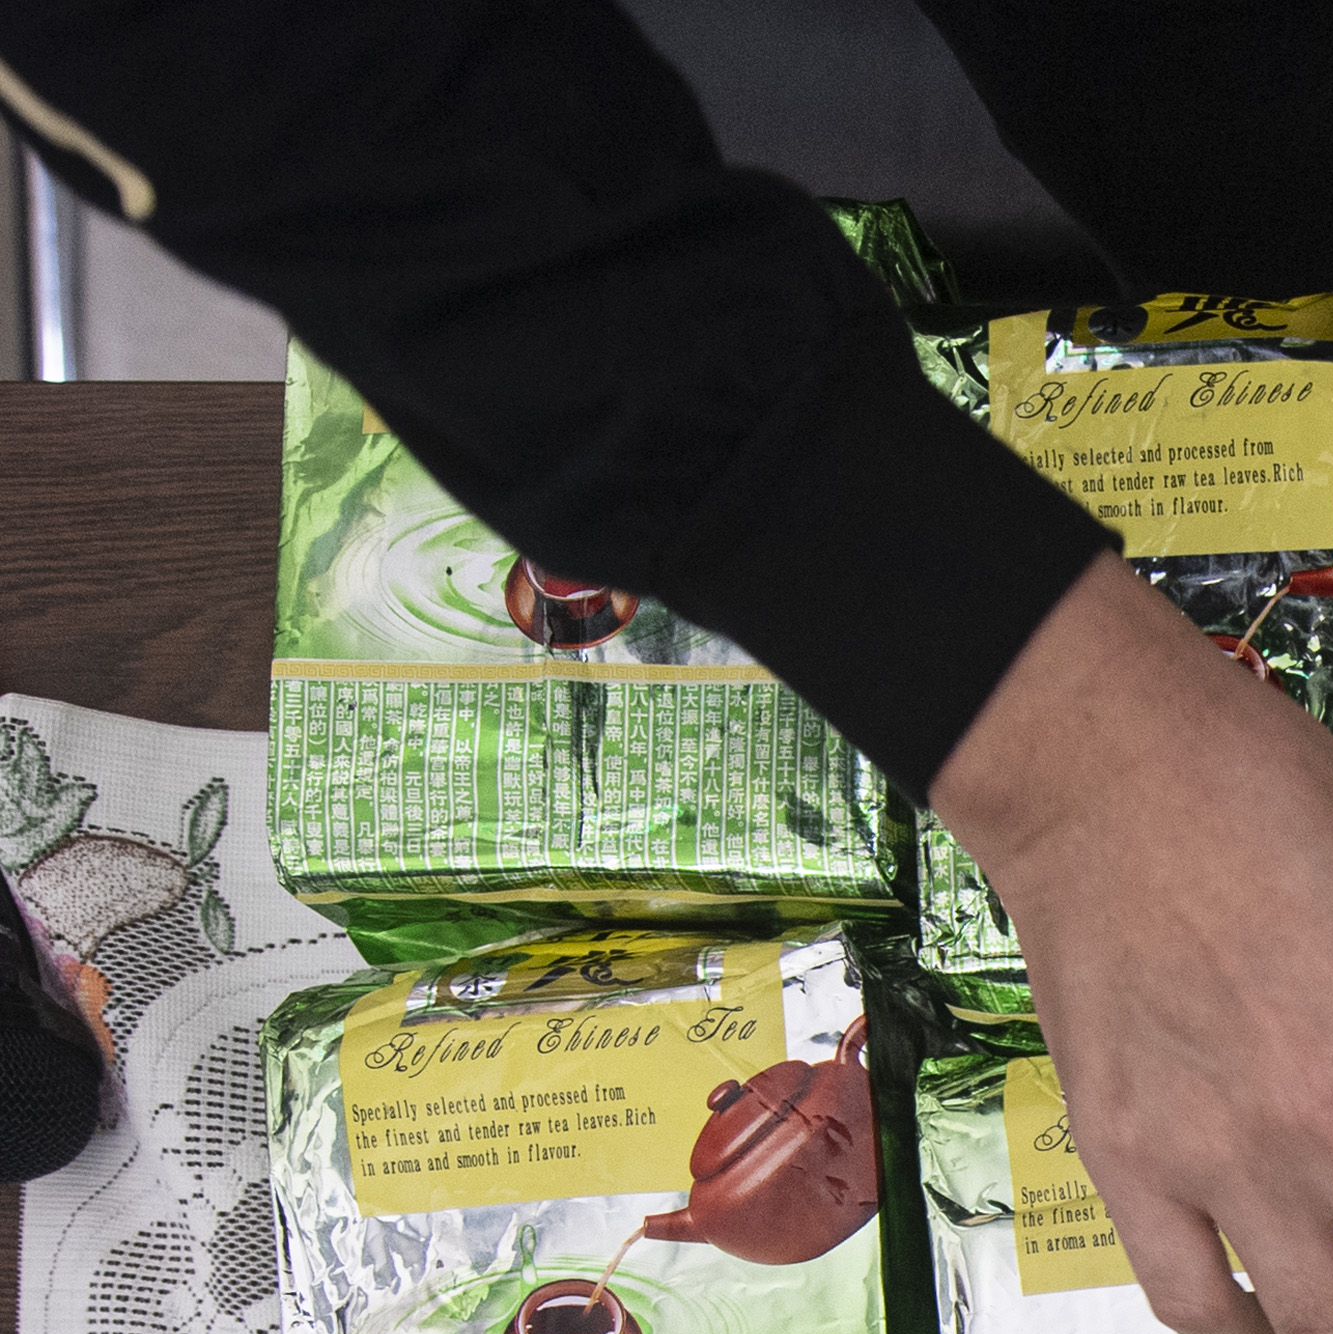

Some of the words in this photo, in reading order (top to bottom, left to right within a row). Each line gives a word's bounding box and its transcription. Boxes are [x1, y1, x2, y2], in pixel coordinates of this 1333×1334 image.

[1015, 373, 1173, 428] Refined
[1072, 445, 1132, 466] selected
[1139, 442, 1161, 463] and
[1167, 438, 1235, 465] processed
[1242, 437, 1274, 456] from
[1081, 473, 1104, 492] and
[1112, 471, 1154, 491] tender
[1163, 473, 1186, 488] raw
[1193, 470, 1215, 487] tea
[1098, 499, 1141, 519] smooth
[365, 1022, 522, 1078] Refined
[686, 1006, 757, 1043] Tea
[351, 1099, 416, 1125] Specially
[425, 1093, 486, 1116] selected
[492, 1090, 515, 1111] and
[521, 1084, 588, 1113] processed
[594, 1083, 625, 1102] from
[355, 1130, 377, 1149] the
[385, 1128, 429, 1147] finest
[437, 1122, 461, 1143] and
[468, 1119, 509, 1140] tender
[518, 1121, 540, 1135] raw
[547, 1117, 569, 1133] tea
[382, 1158, 421, 1174] aroma
[427, 1151, 449, 1171] and
[456, 1147, 499, 1168] smooth
[1021, 1180, 1088, 1208] Specially
[1052, 1204, 1095, 1224] finest
[1046, 1235, 1086, 1251] aroma
